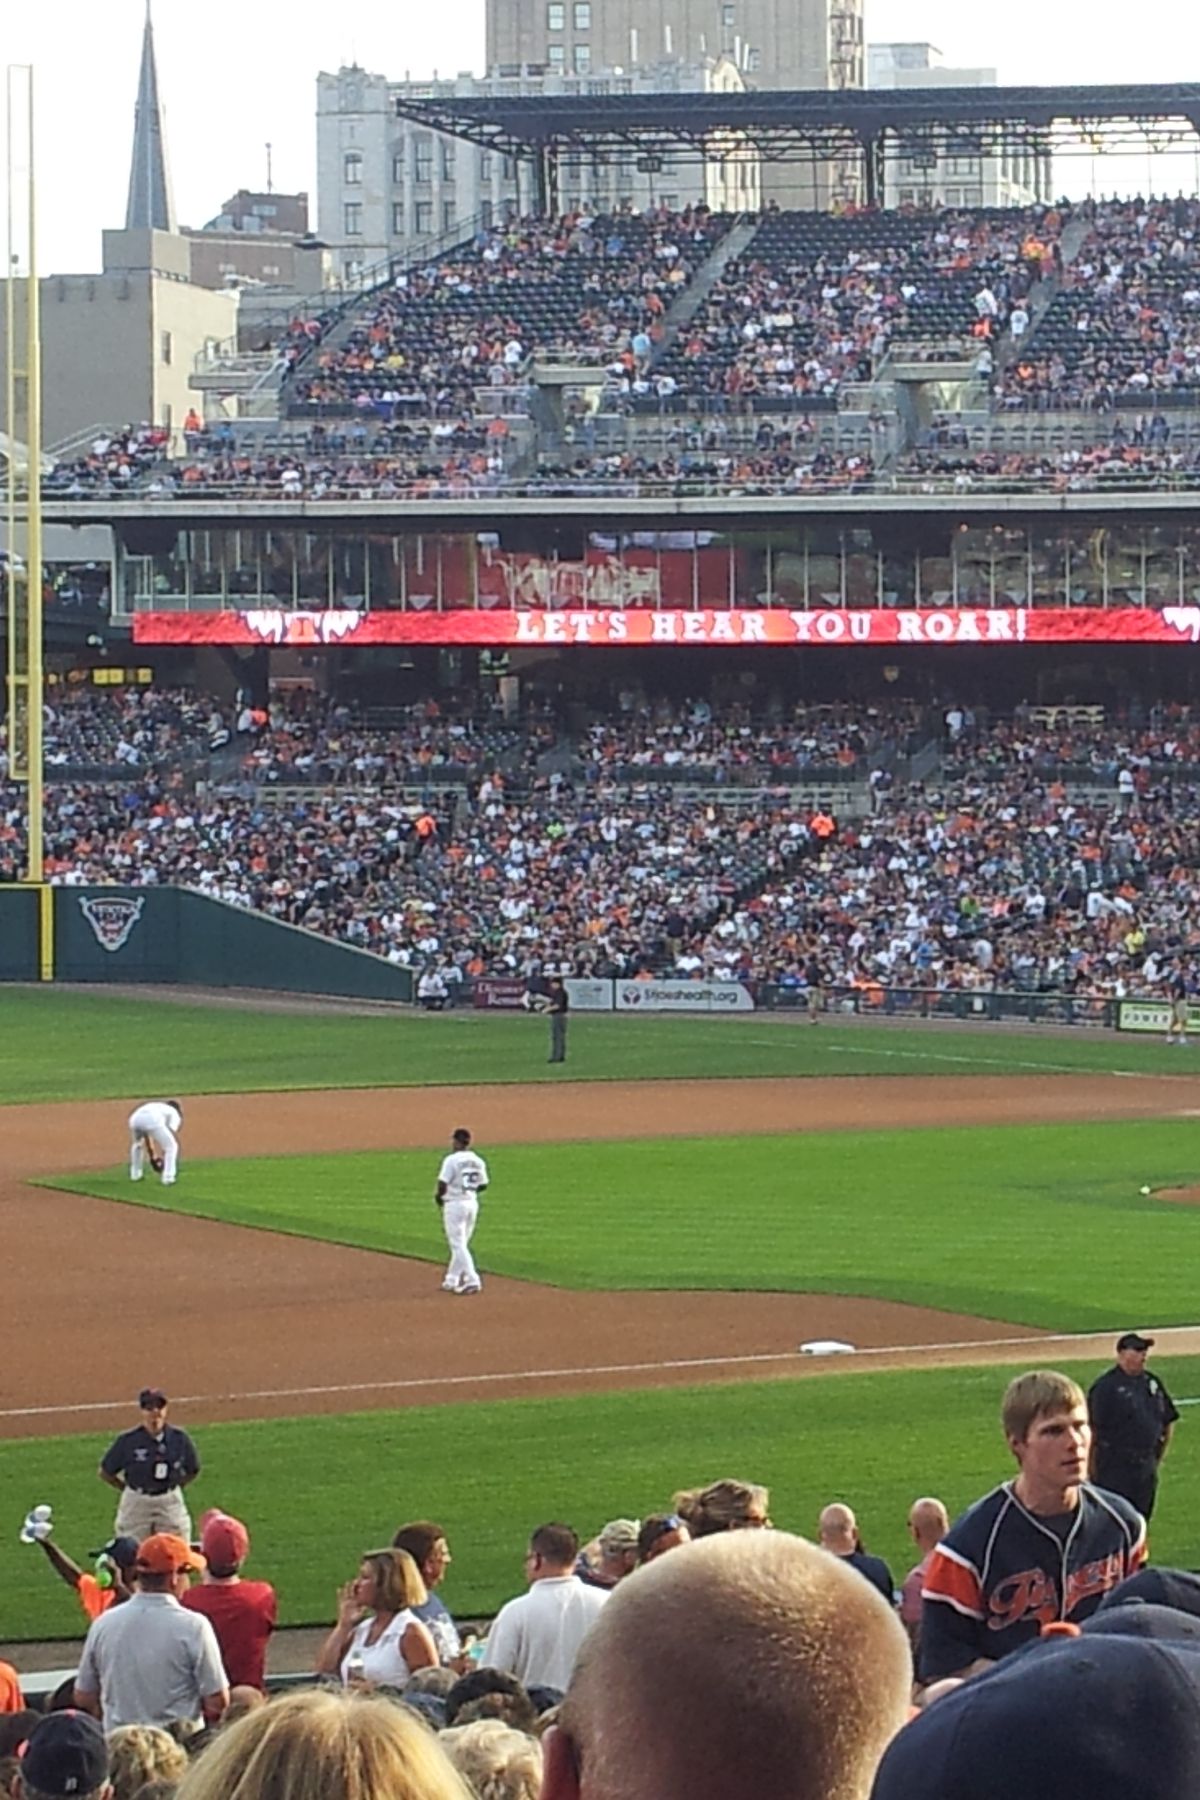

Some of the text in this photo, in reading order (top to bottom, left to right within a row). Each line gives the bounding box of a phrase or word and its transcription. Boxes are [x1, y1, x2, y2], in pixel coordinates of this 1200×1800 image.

[515, 608, 1027, 641] LET'S HEAR YOU ROAR!
